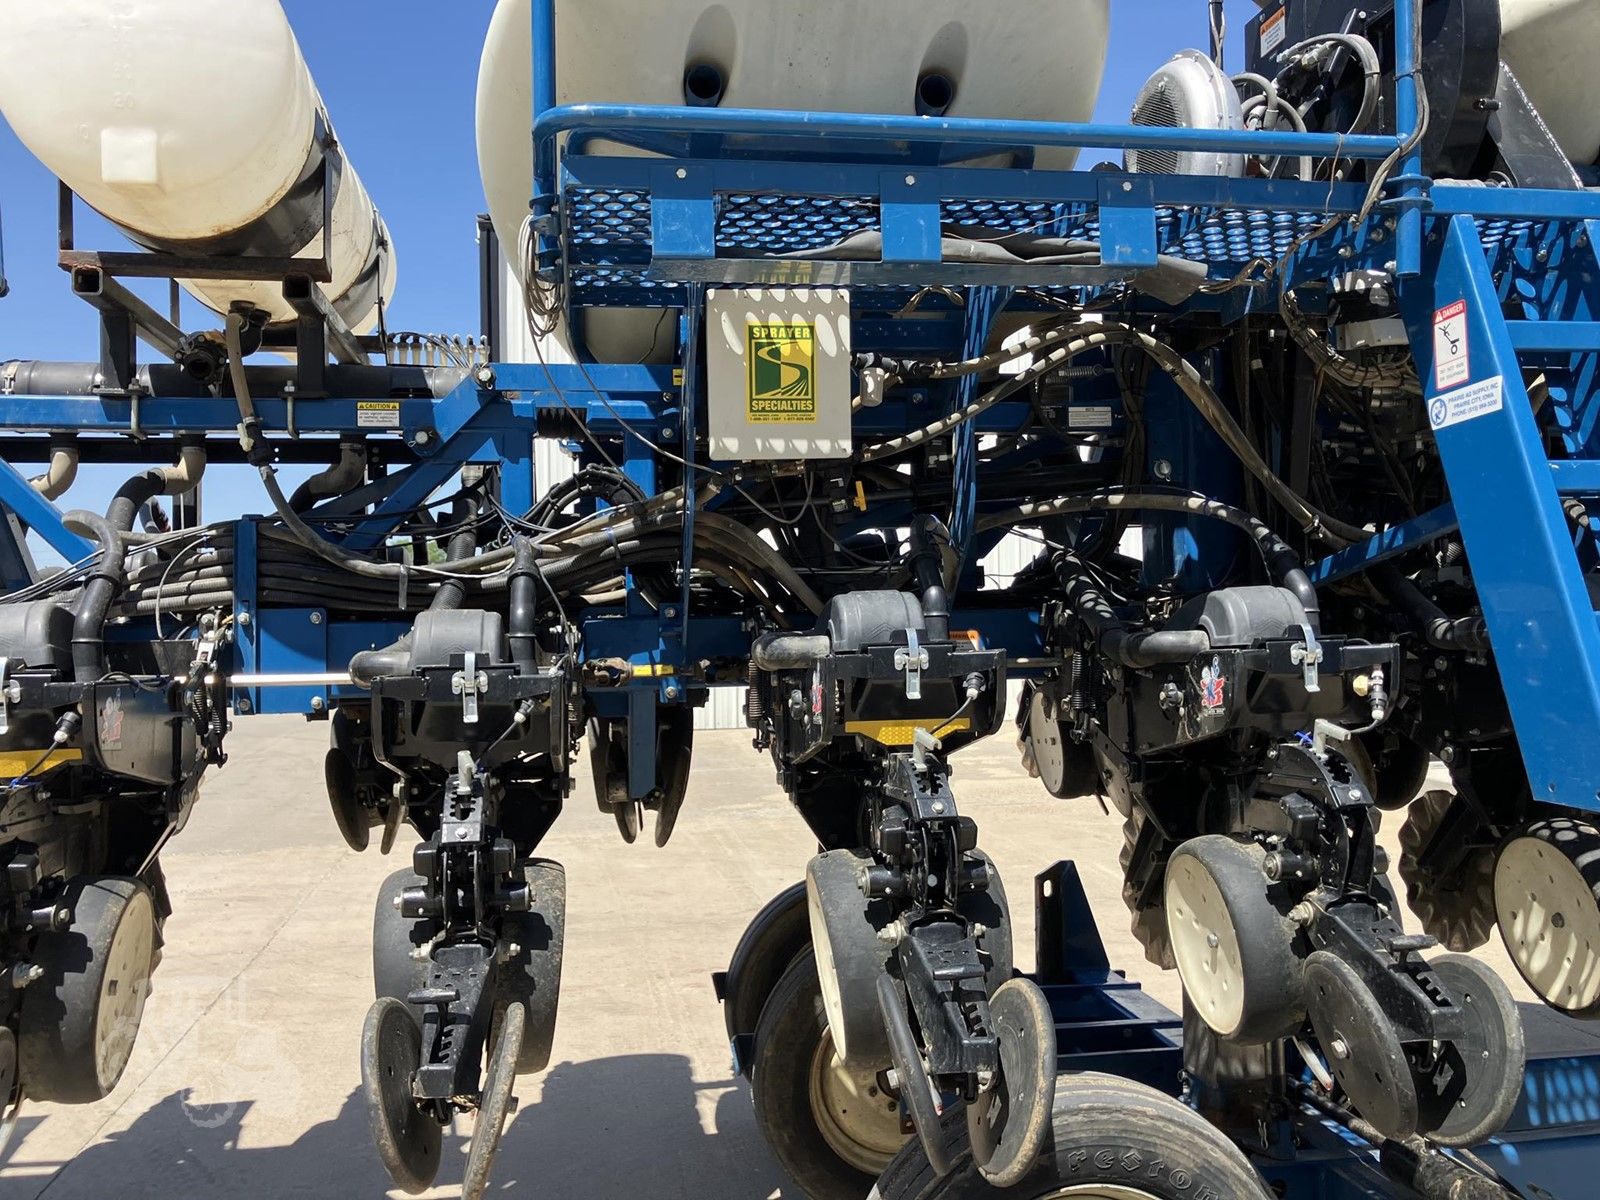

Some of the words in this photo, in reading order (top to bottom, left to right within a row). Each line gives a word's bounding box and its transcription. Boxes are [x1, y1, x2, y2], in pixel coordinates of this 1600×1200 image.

[1442, 302, 1464, 318] DANGER
[752, 327, 811, 339] SPRAYER
[751, 400, 813, 411] SPECIALTIES
[1067, 1148, 1219, 1200] reston
